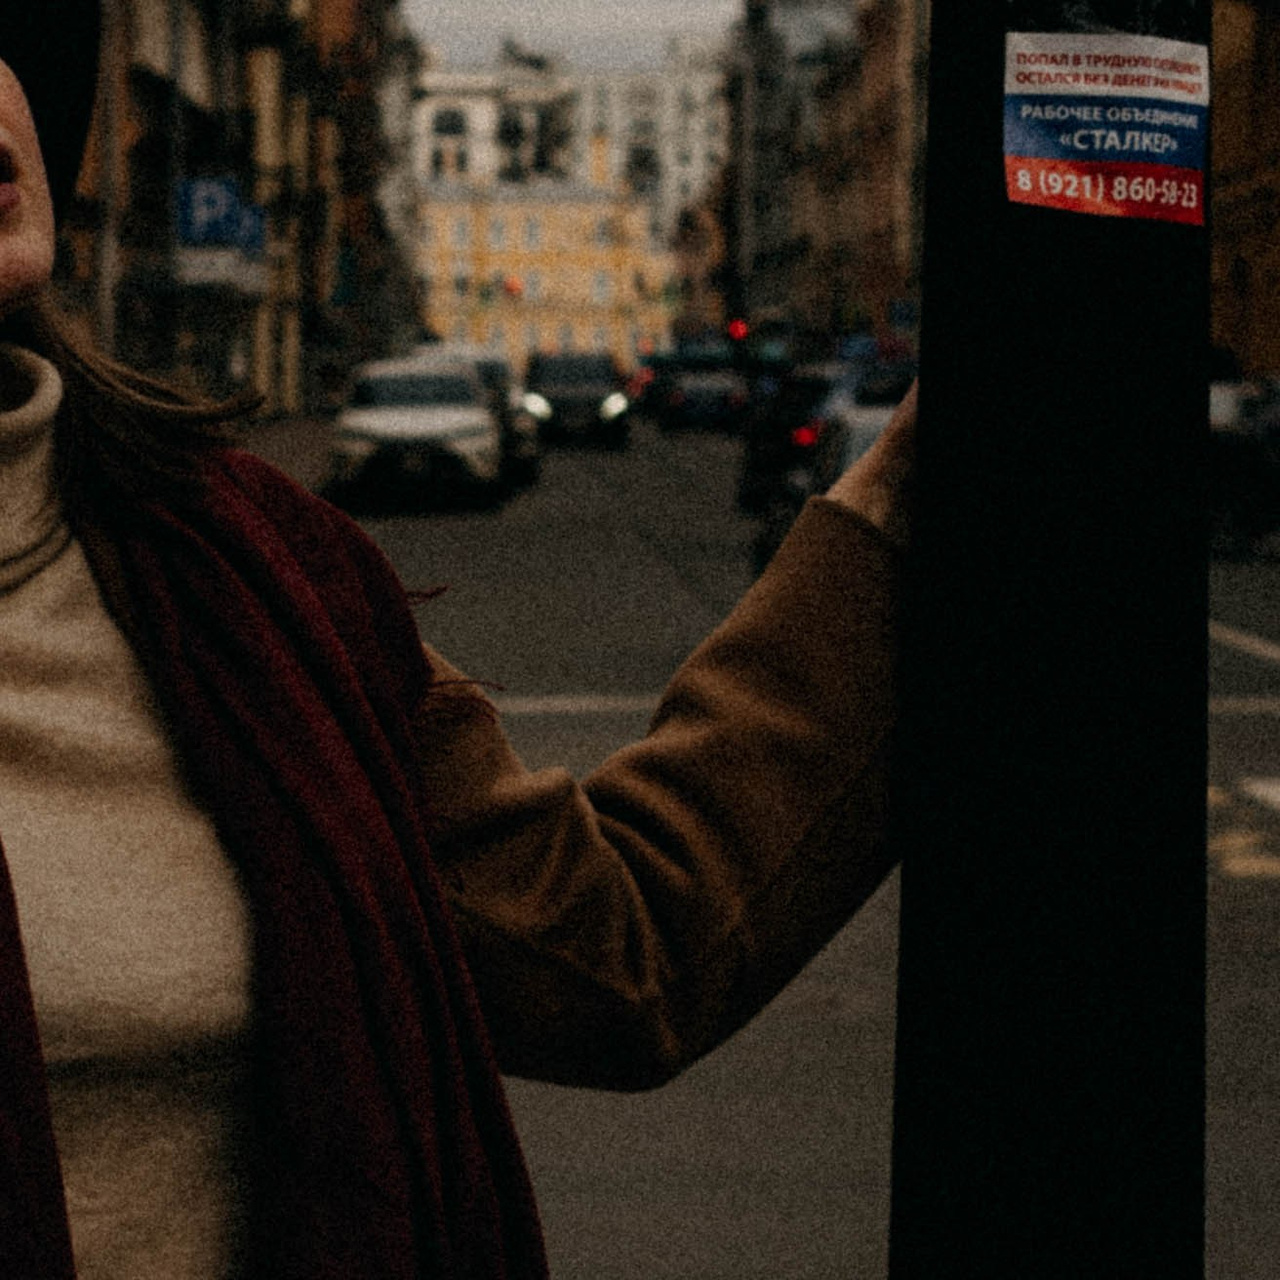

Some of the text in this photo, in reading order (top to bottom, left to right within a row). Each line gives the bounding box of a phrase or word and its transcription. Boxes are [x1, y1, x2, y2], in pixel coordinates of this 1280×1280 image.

[1017, 52, 1068, 65] ПОПАЛ
[1072, 53, 1081, 66] В
[1085, 53, 1152, 68] ТРУДНУЮ
[1016, 71, 1081, 85] ОСТАЛСЯ
[1083, 72, 1109, 86] БЕЗ
[1021, 104, 1103, 121] РАБОЧЕЕ
[1060, 128, 1179, 154] «СТАЛКЕР»
[1017, 169, 1197, 209] 8 (921) 860-58-23
